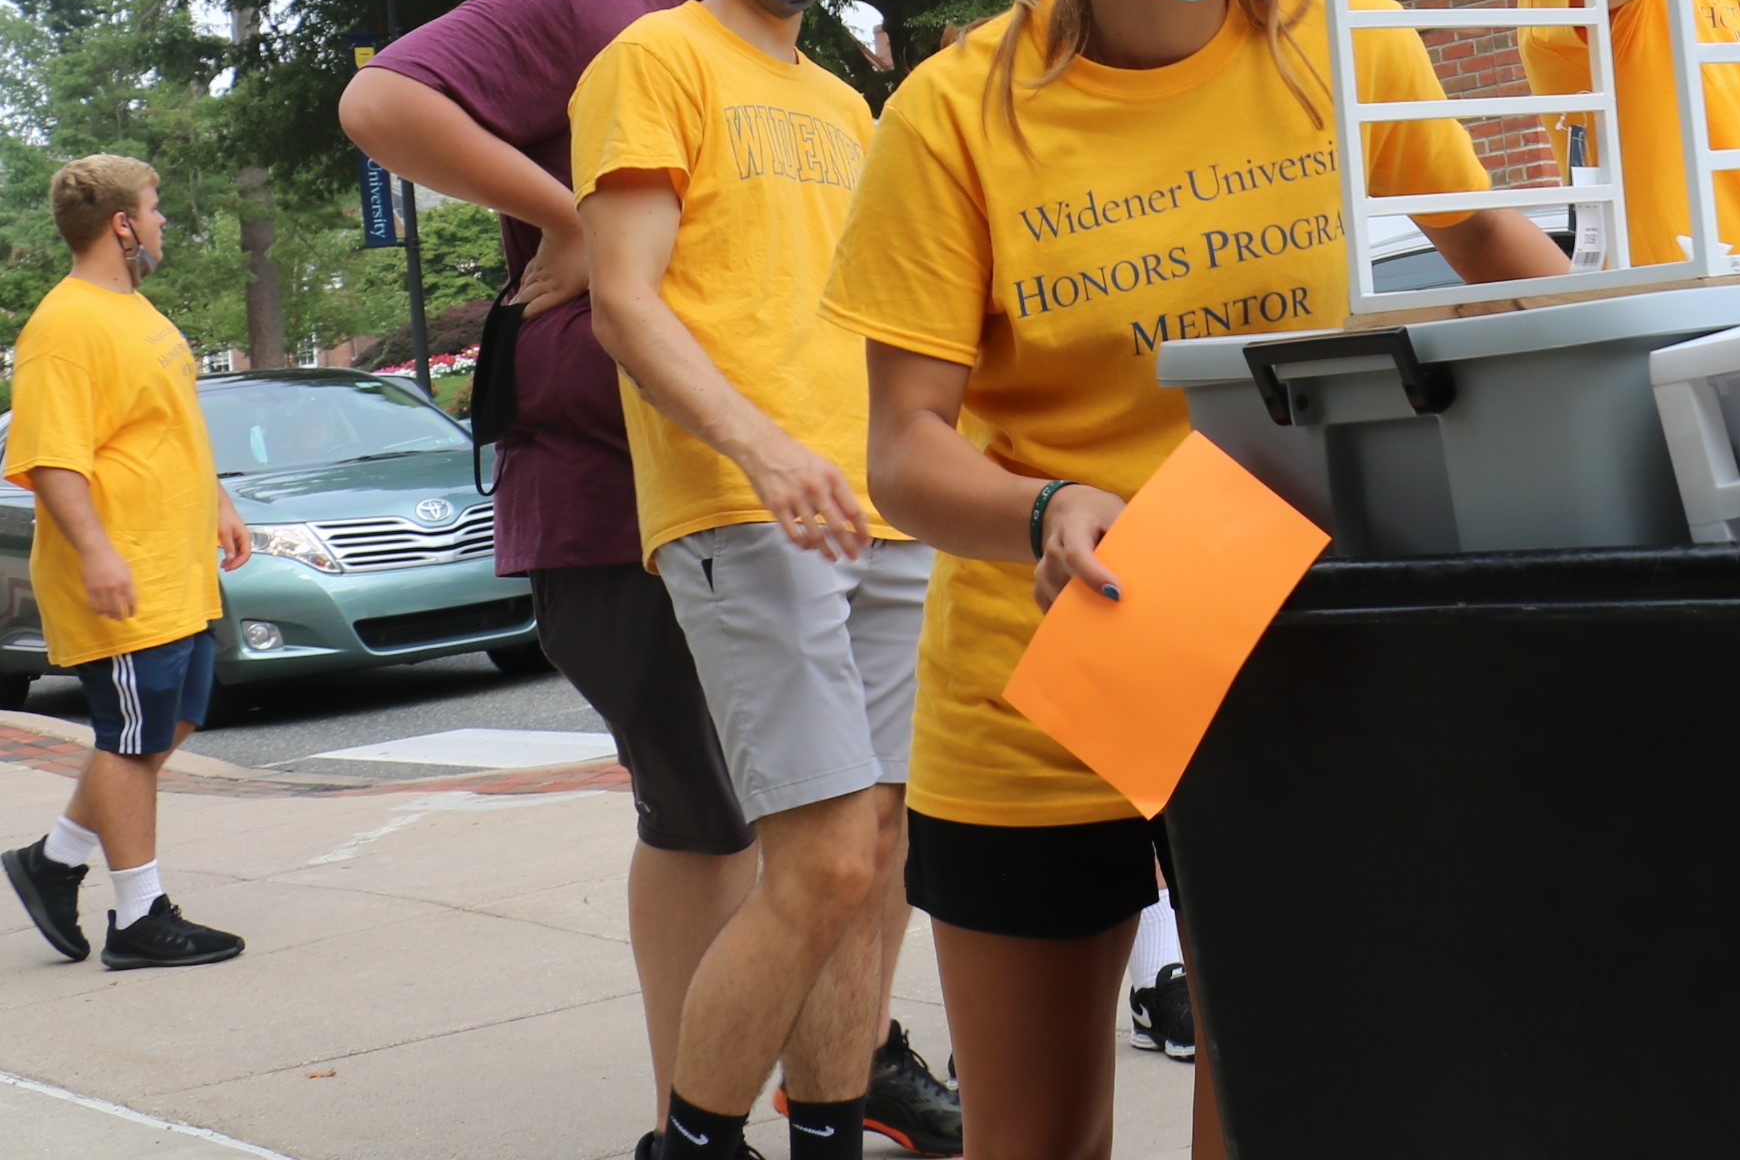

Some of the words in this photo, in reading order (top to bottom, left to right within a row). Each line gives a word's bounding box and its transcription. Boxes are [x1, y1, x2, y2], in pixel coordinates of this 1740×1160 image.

[724, 104, 863, 191] WIDENE
[1018, 182, 1184, 242] Widener
[1184, 140, 1338, 202] Universi
[1013, 245, 1191, 319] HONORS
[1202, 208, 1346, 270] PROGRA
[1130, 286, 1313, 357] MENTOR
